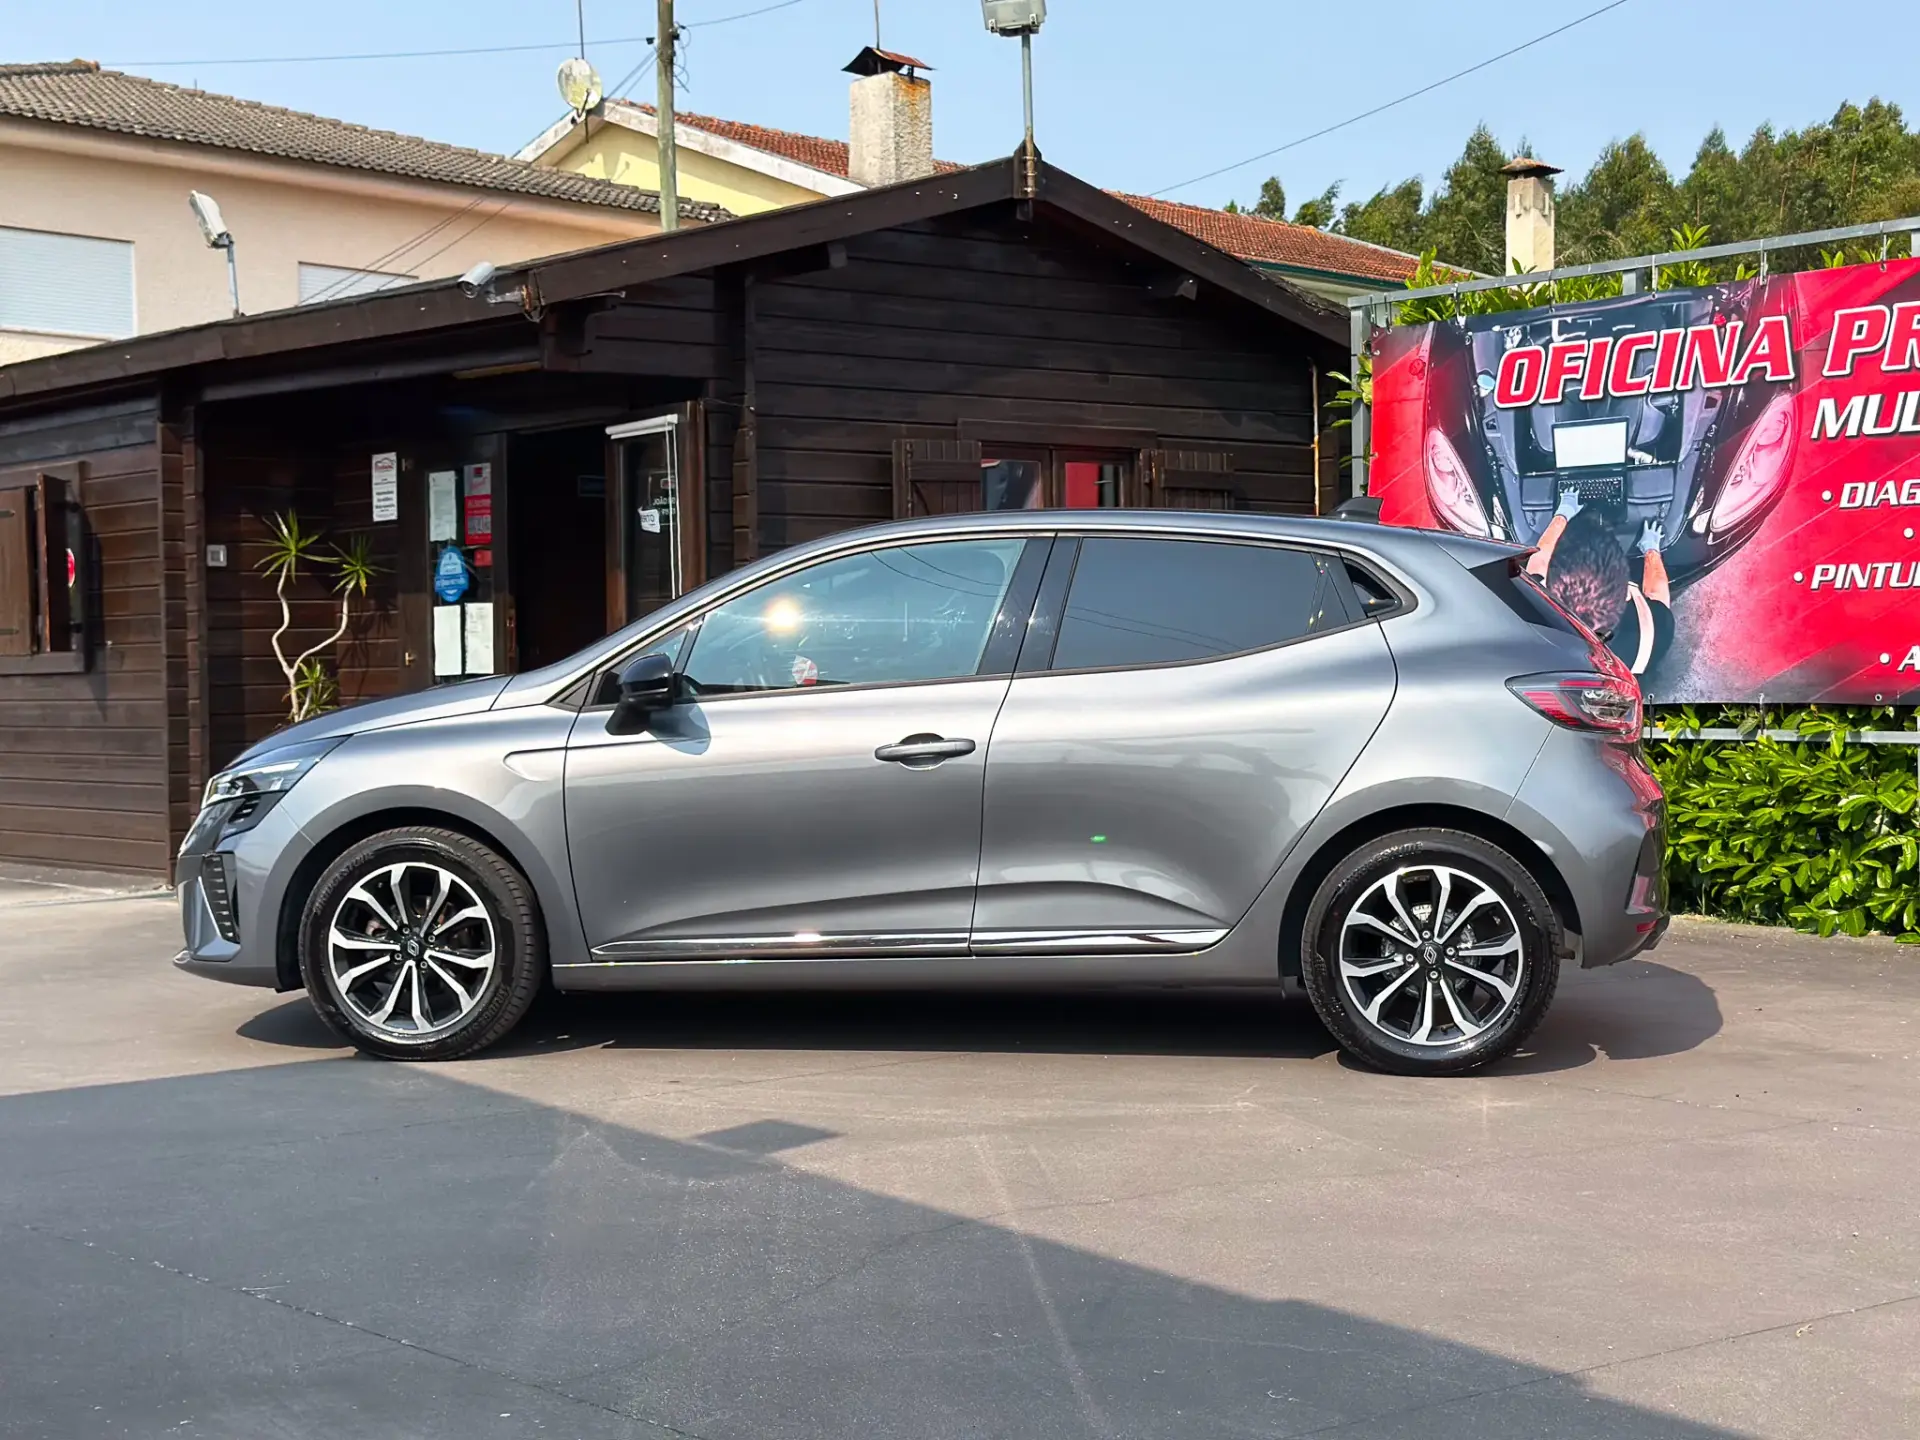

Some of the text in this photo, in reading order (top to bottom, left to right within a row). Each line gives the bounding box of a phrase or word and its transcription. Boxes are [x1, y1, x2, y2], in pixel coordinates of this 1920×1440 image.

[1493, 315, 1796, 409] OFICINA
[1839, 479, 1920, 509] DIAG
[1811, 561, 1920, 590] PINTU
